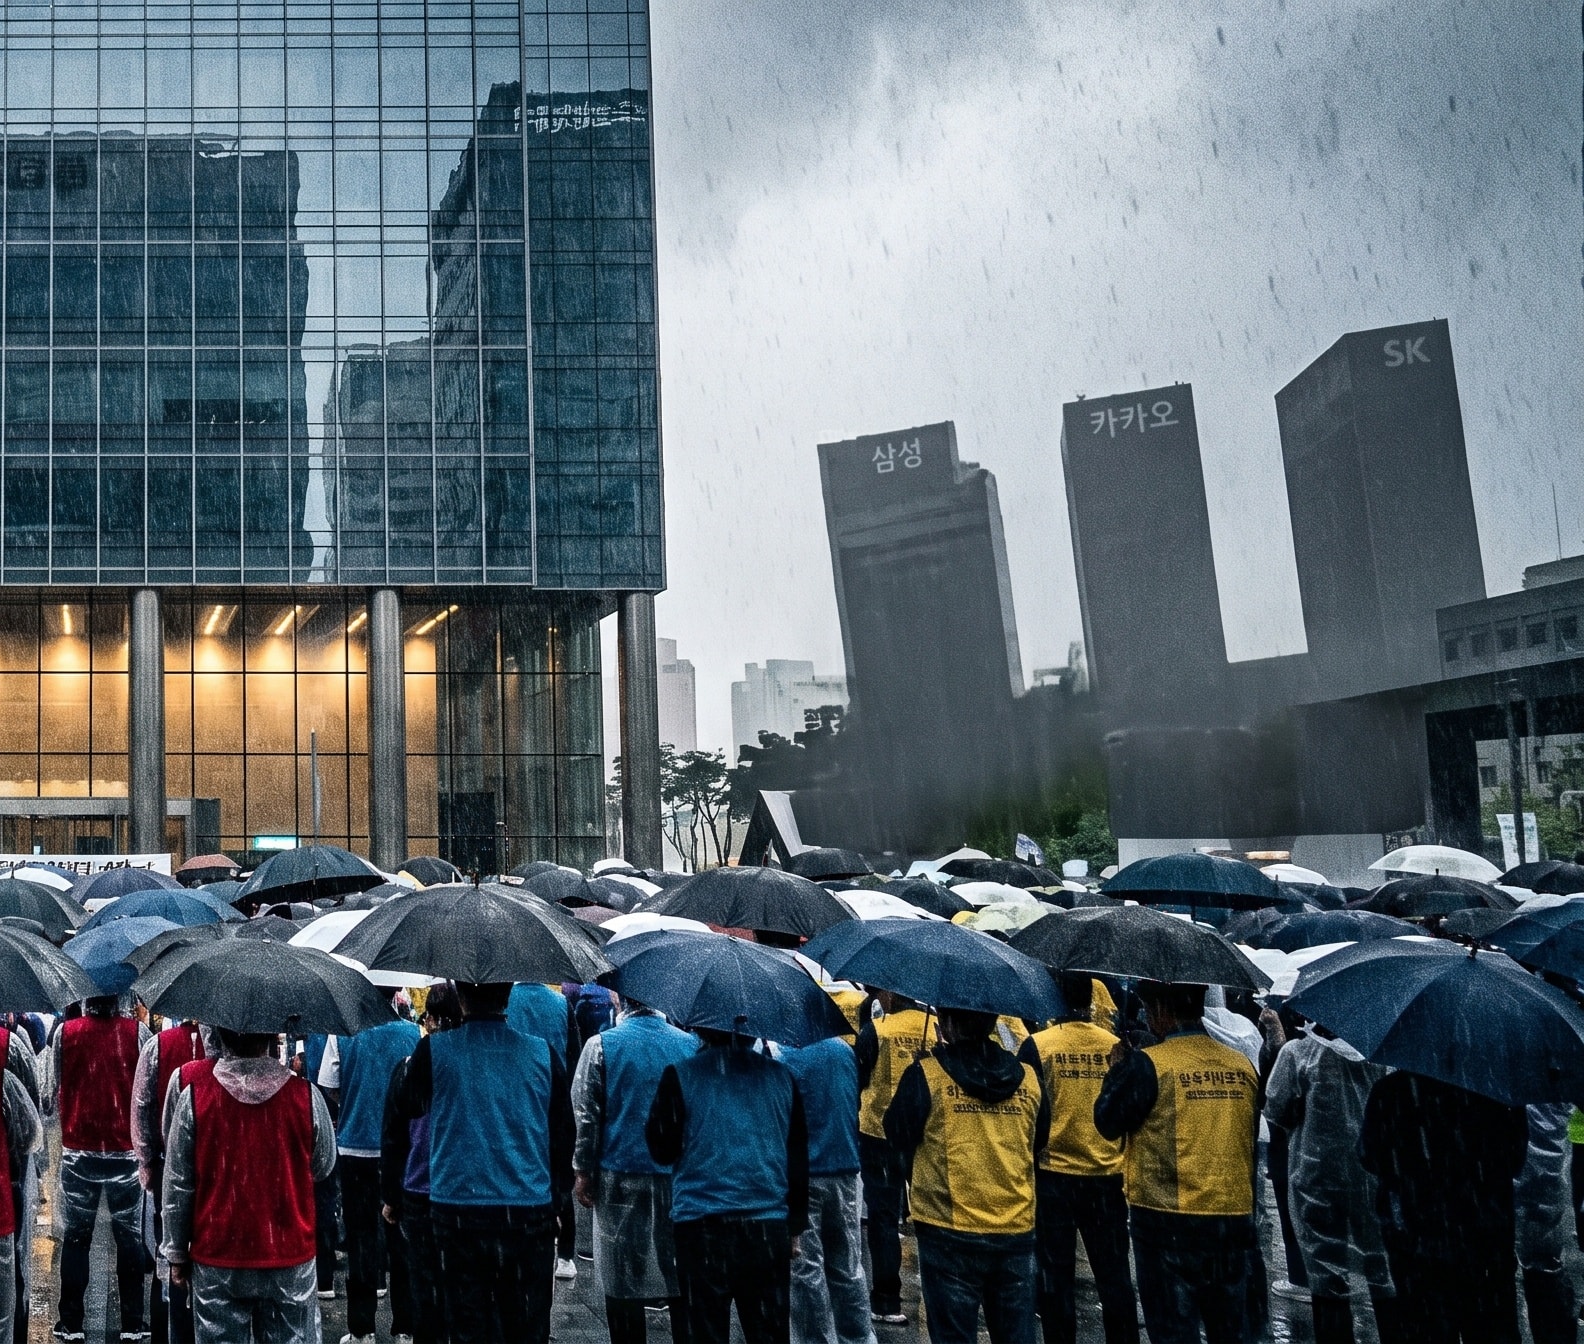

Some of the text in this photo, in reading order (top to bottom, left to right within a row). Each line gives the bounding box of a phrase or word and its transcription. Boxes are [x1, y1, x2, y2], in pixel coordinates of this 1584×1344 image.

[1383, 336, 1431, 367] SK
[1089, 399, 1180, 440] 카카오
[871, 437, 923, 475] 삼성
